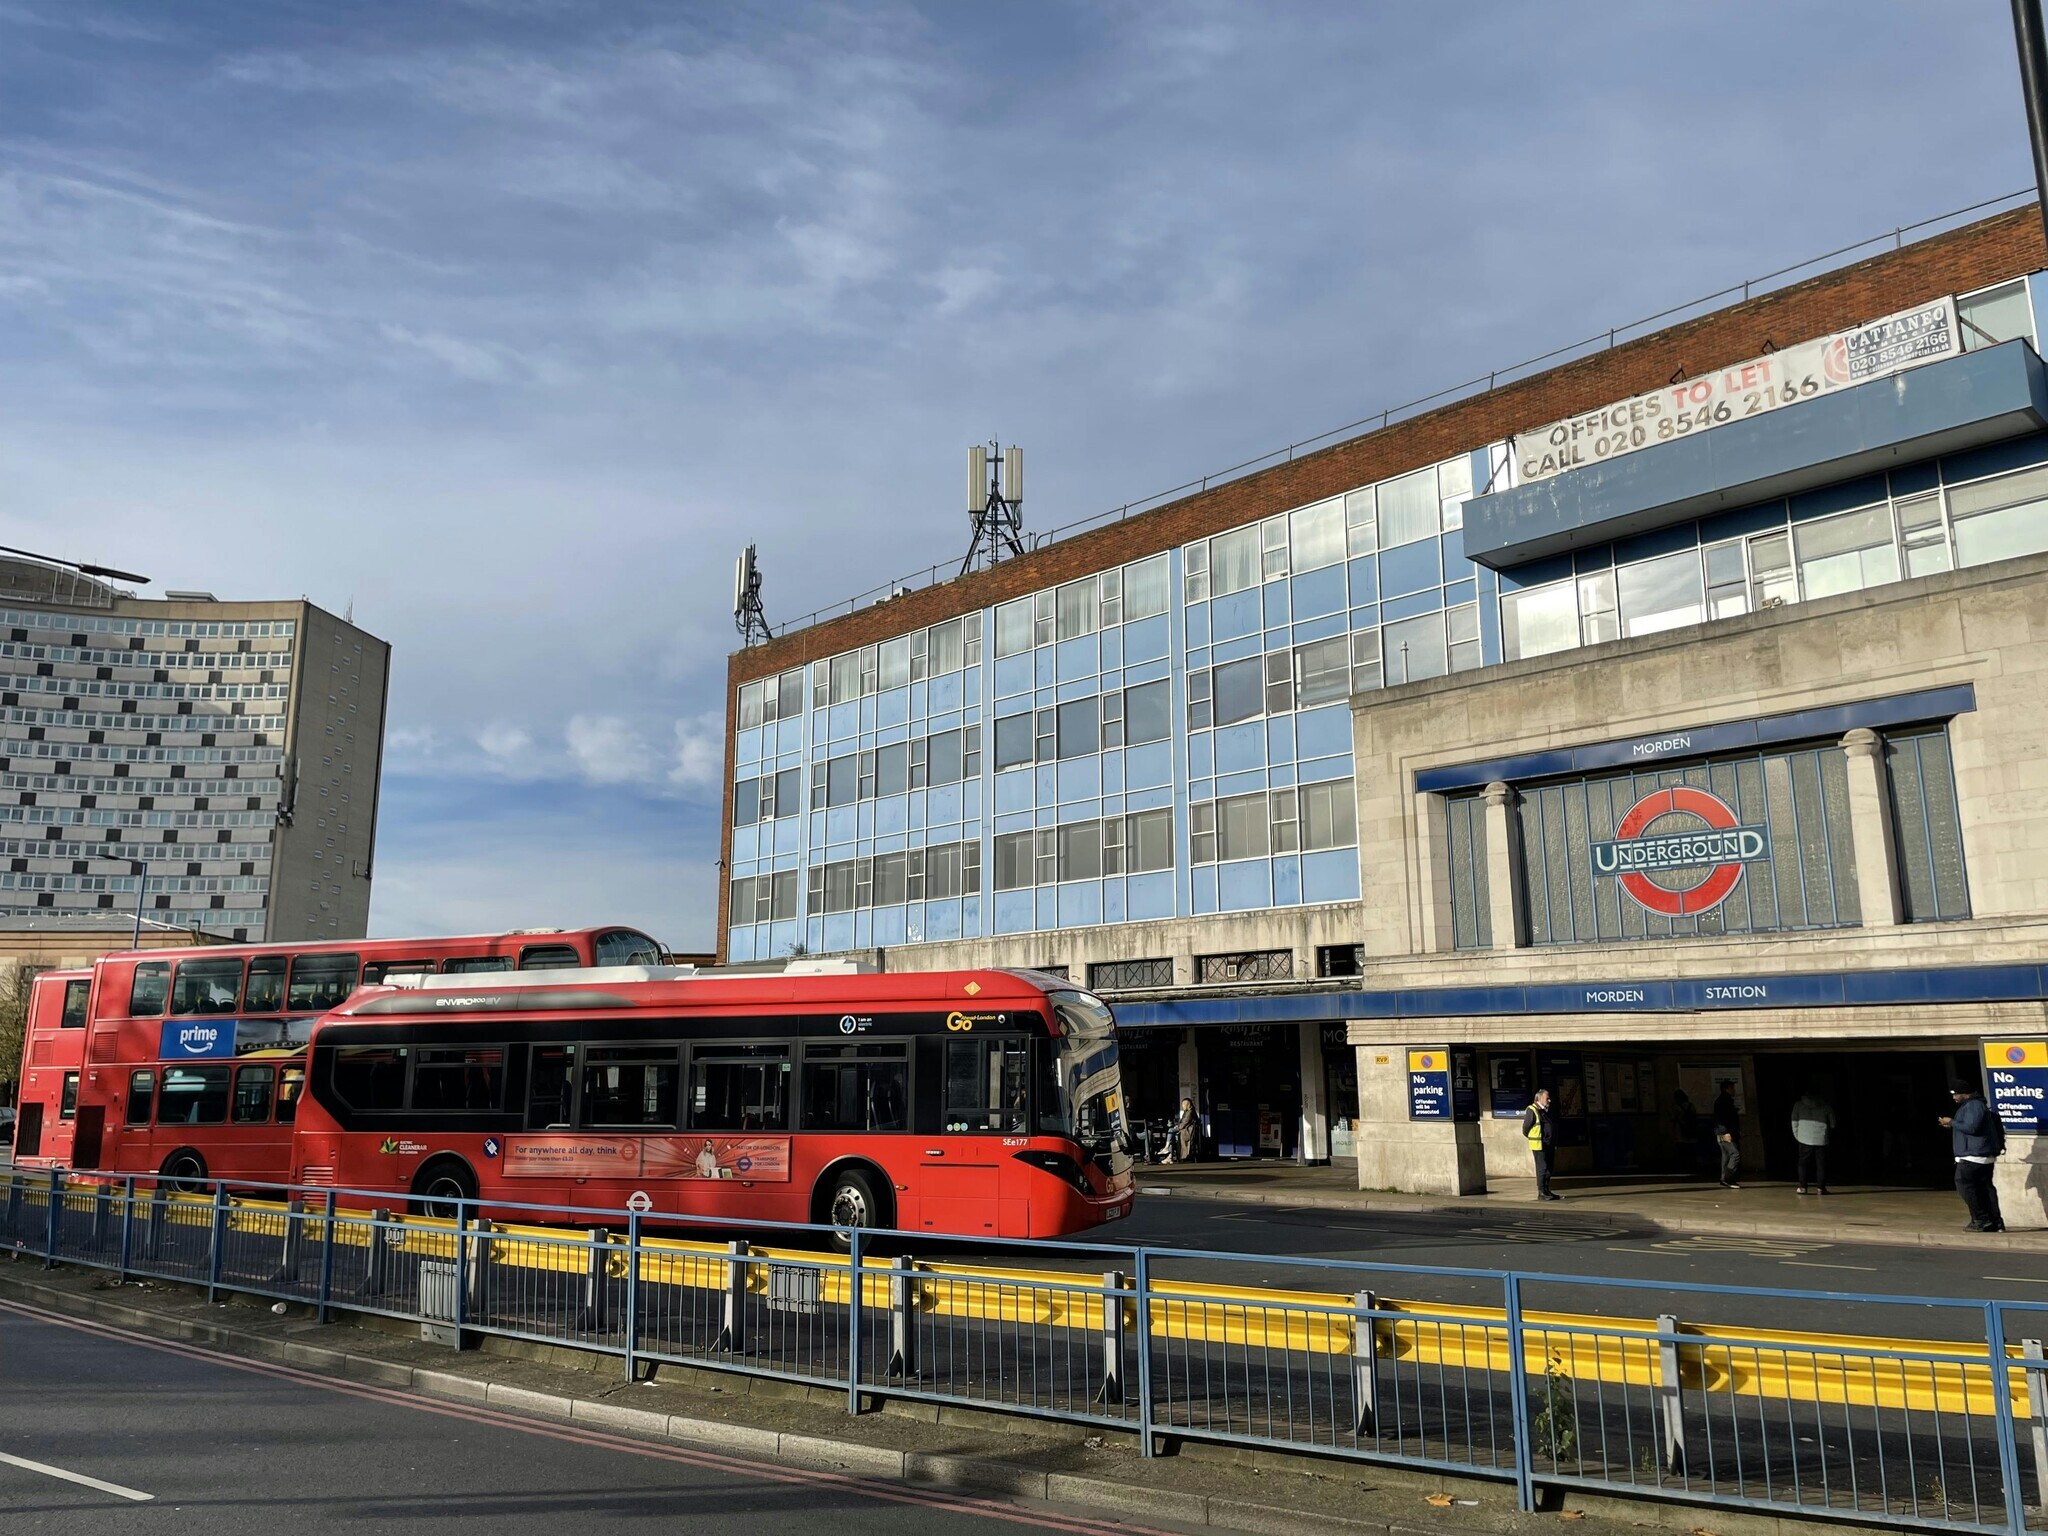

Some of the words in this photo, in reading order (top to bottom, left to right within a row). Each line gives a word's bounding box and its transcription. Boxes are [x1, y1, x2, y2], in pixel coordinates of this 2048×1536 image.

[1847, 306, 1944, 350] CATTANEO
[1850, 321, 1946, 357] COMMERCIAL
[1851, 355, 1876, 371] 020
[1880, 343, 1913, 362] 8546
[1916, 331, 1948, 349] 2166
[1549, 395, 1662, 446] OFFICES
[1672, 380, 1713, 409] TO
[1724, 360, 1772, 394] LET
[1522, 445, 1586, 478] CALL
[1594, 425, 1646, 457] 020
[1657, 400, 1732, 439] 8546
[1743, 374, 1819, 415] 2166
[1633, 736, 1691, 756] MORDEN
[1596, 830, 1764, 872] UNDERGROUND
[1586, 990, 1644, 1003] MORDEN
[1705, 985, 1767, 999] STATION
[946, 1011, 973, 1031] Go
[179, 1025, 218, 1044] prime
[1413, 1074, 1426, 1084] No
[1993, 1071, 2014, 1083] No
[1414, 1085, 1444, 1096] parking
[1995, 1085, 2044, 1099] parking
[1997, 1102, 2034, 1110] Offenders
[515, 1146, 528, 1154] For
[529, 1145, 566, 1156] anywhere
[568, 1145, 578, 1154] all
[579, 1146, 595, 1156] day,
[597, 1146, 617, 1155] think
[1002, 1138, 1028, 1146] SEe177
